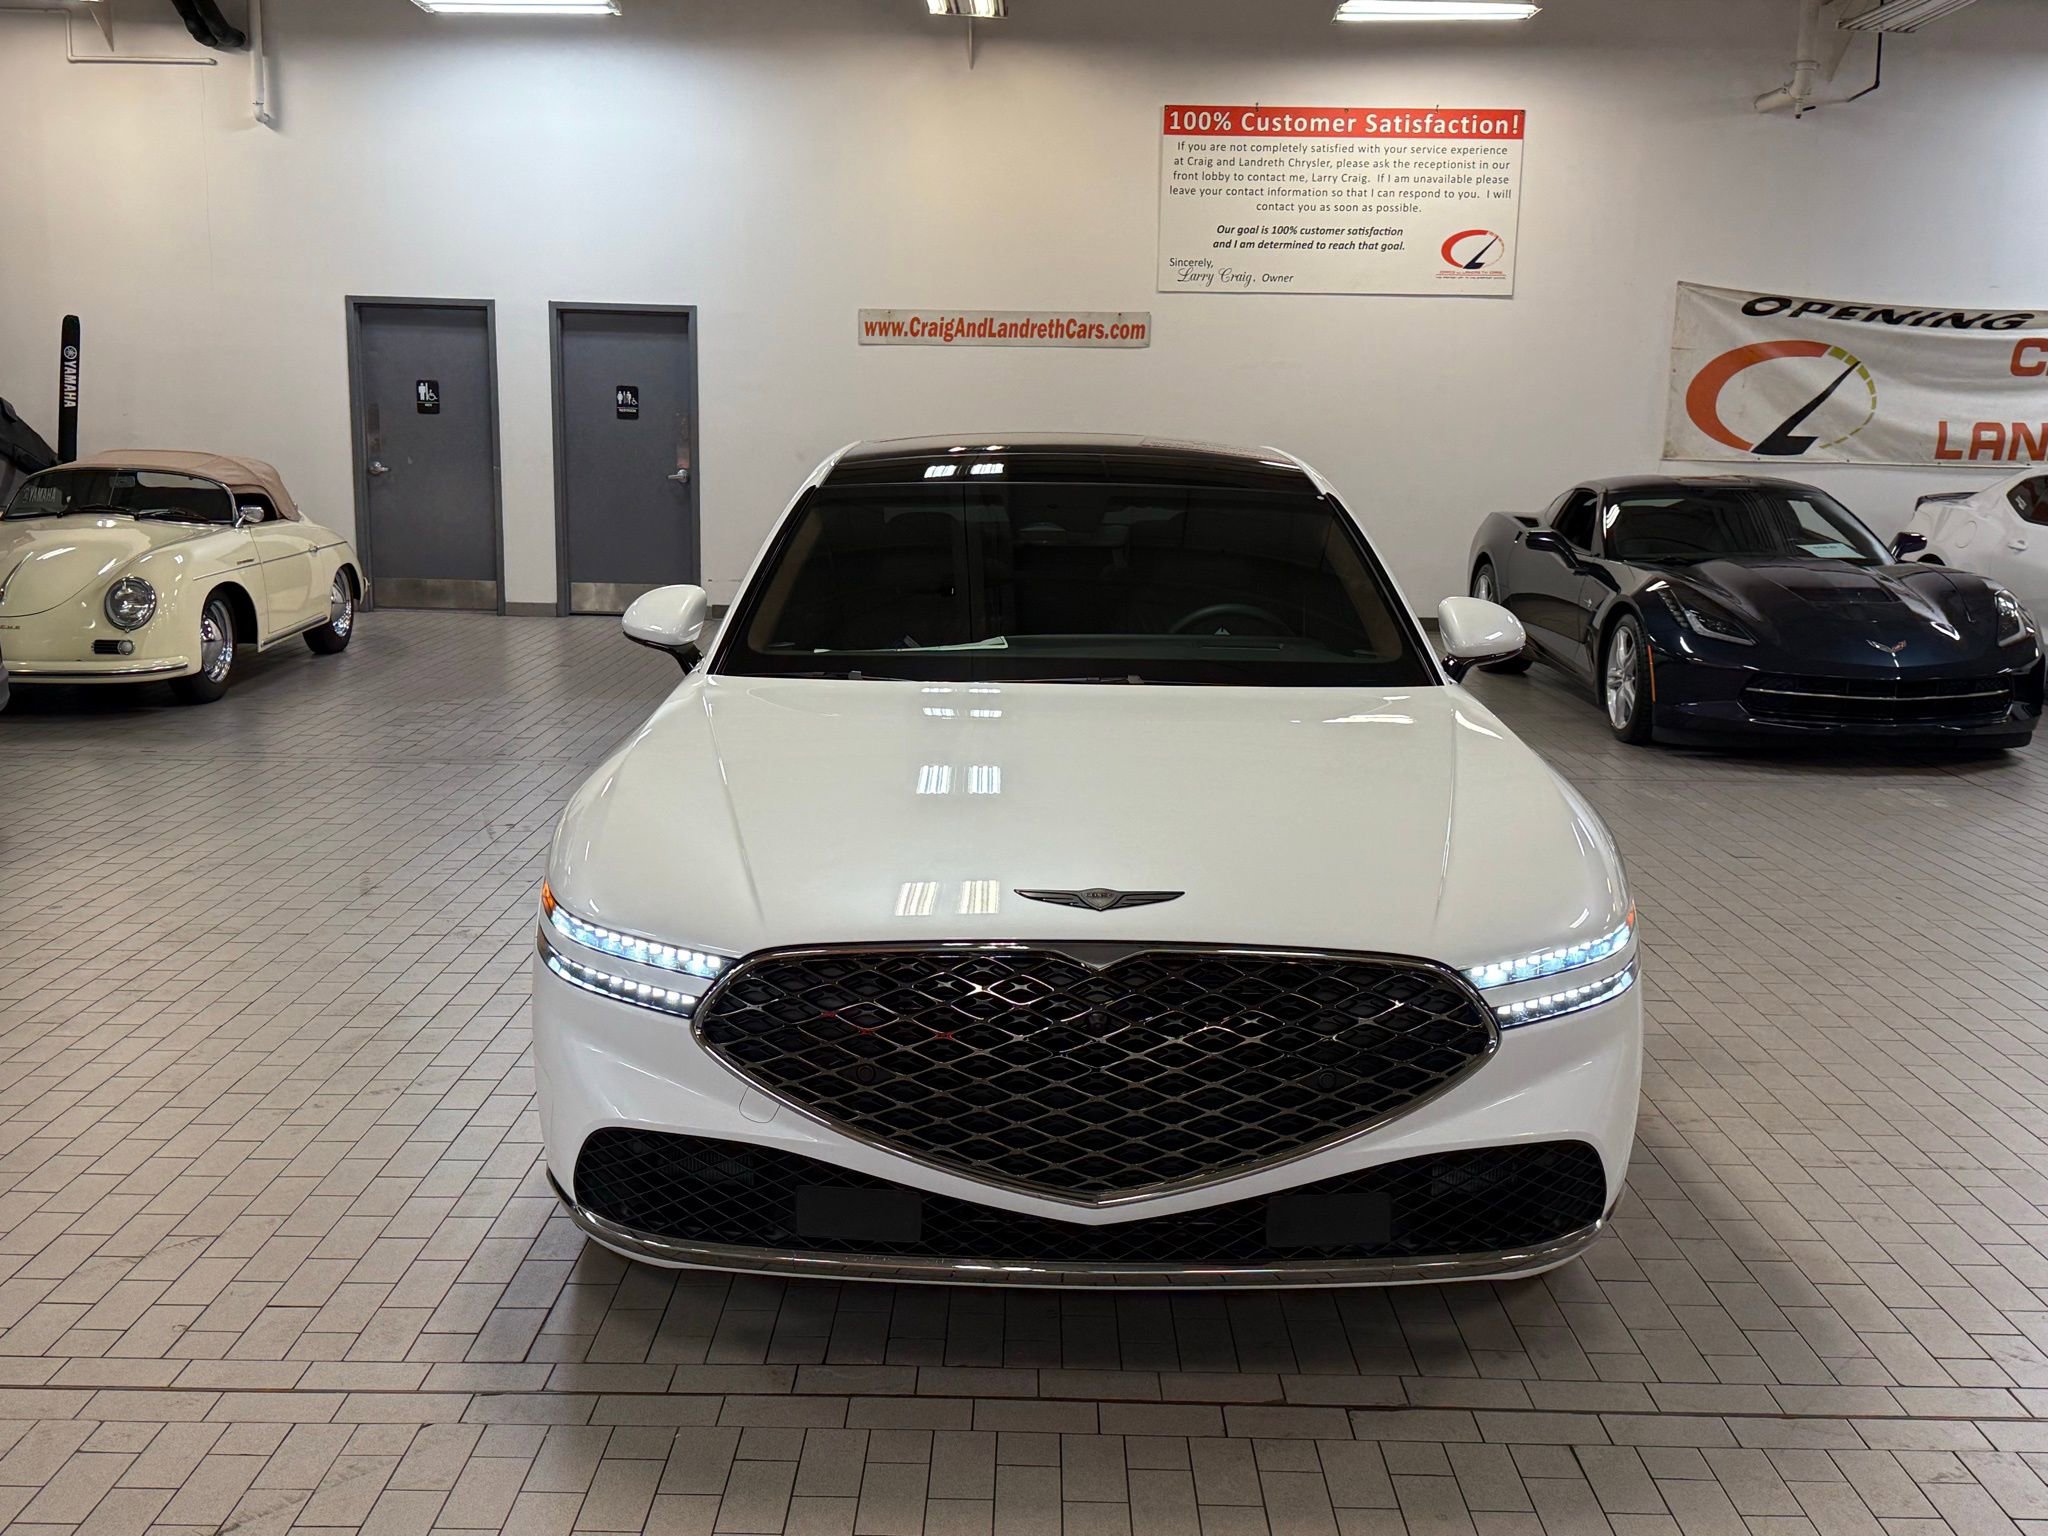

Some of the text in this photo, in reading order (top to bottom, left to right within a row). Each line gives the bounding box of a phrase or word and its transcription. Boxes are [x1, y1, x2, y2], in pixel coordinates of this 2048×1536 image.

[1169, 111, 1519, 134] 100% Customer Satisfaction!
[1177, 142, 1186, 150] If
[1188, 143, 1206, 153] you
[1230, 143, 1246, 152] not
[1250, 143, 1307, 154] completely
[1311, 143, 1355, 154] satisfied
[1358, 143, 1381, 155] with
[1384, 145, 1406, 155] your
[1411, 145, 1447, 154] service
[1451, 146, 1507, 156] experience
[1187, 157, 1213, 168] Craig
[1217, 158, 1235, 166] and
[1239, 158, 1284, 166] Landreth
[1288, 158, 1332, 169] Chrysler,
[1336, 158, 1370, 170] please
[1373, 160, 1389, 168] ask
[1393, 160, 1410, 168] the
[1414, 160, 1475, 170] receptionist
[1480, 161, 1488, 169] in
[1173, 171, 1198, 180] front
[1202, 172, 1230, 183] lobby
[1234, 173, 1244, 181] to
[1248, 173, 1285, 181] contact
[1289, 175, 1308, 183] me,
[1311, 173, 1338, 184] Larry
[1341, 173, 1370, 184] Craig.
[1377, 174, 1385, 182] If
[1414, 175, 1472, 183] unavailable
[1476, 176, 1509, 186] please
[1170, 186, 1196, 195] leave
[1200, 188, 1221, 197] your
[1226, 188, 1264, 196] contact
[1268, 187, 1327, 196] information
[1331, 188, 1343, 197] so
[1346, 188, 1367, 197] that
[1399, 189, 1440, 199] respond
[1444, 190, 1454, 198] to
[1458, 191, 1480, 200] you.
[1493, 190, 1511, 198] will
[1256, 203, 1294, 211] contact
[1299, 204, 1316, 213] you
[1376, 204, 1421, 213] possible.
[1217, 225, 1403, 237] Our goal is 100% customer satisfaction
[1213, 240, 1232, 248] and
[1257, 240, 1313, 249] determined
[1328, 241, 1355, 250] reach
[1359, 241, 1378, 250] that
[1381, 241, 1405, 252] goal.
[1169, 258, 1214, 268] Sincerely,
[1177, 267, 1214, 287] Larry
[1262, 274, 1294, 282] Owner
[1741, 296, 2035, 331] OPENING
[864, 316, 1146, 342] www.CraigAndLandrethCars.com
[64, 360, 77, 408] YAMAHA
